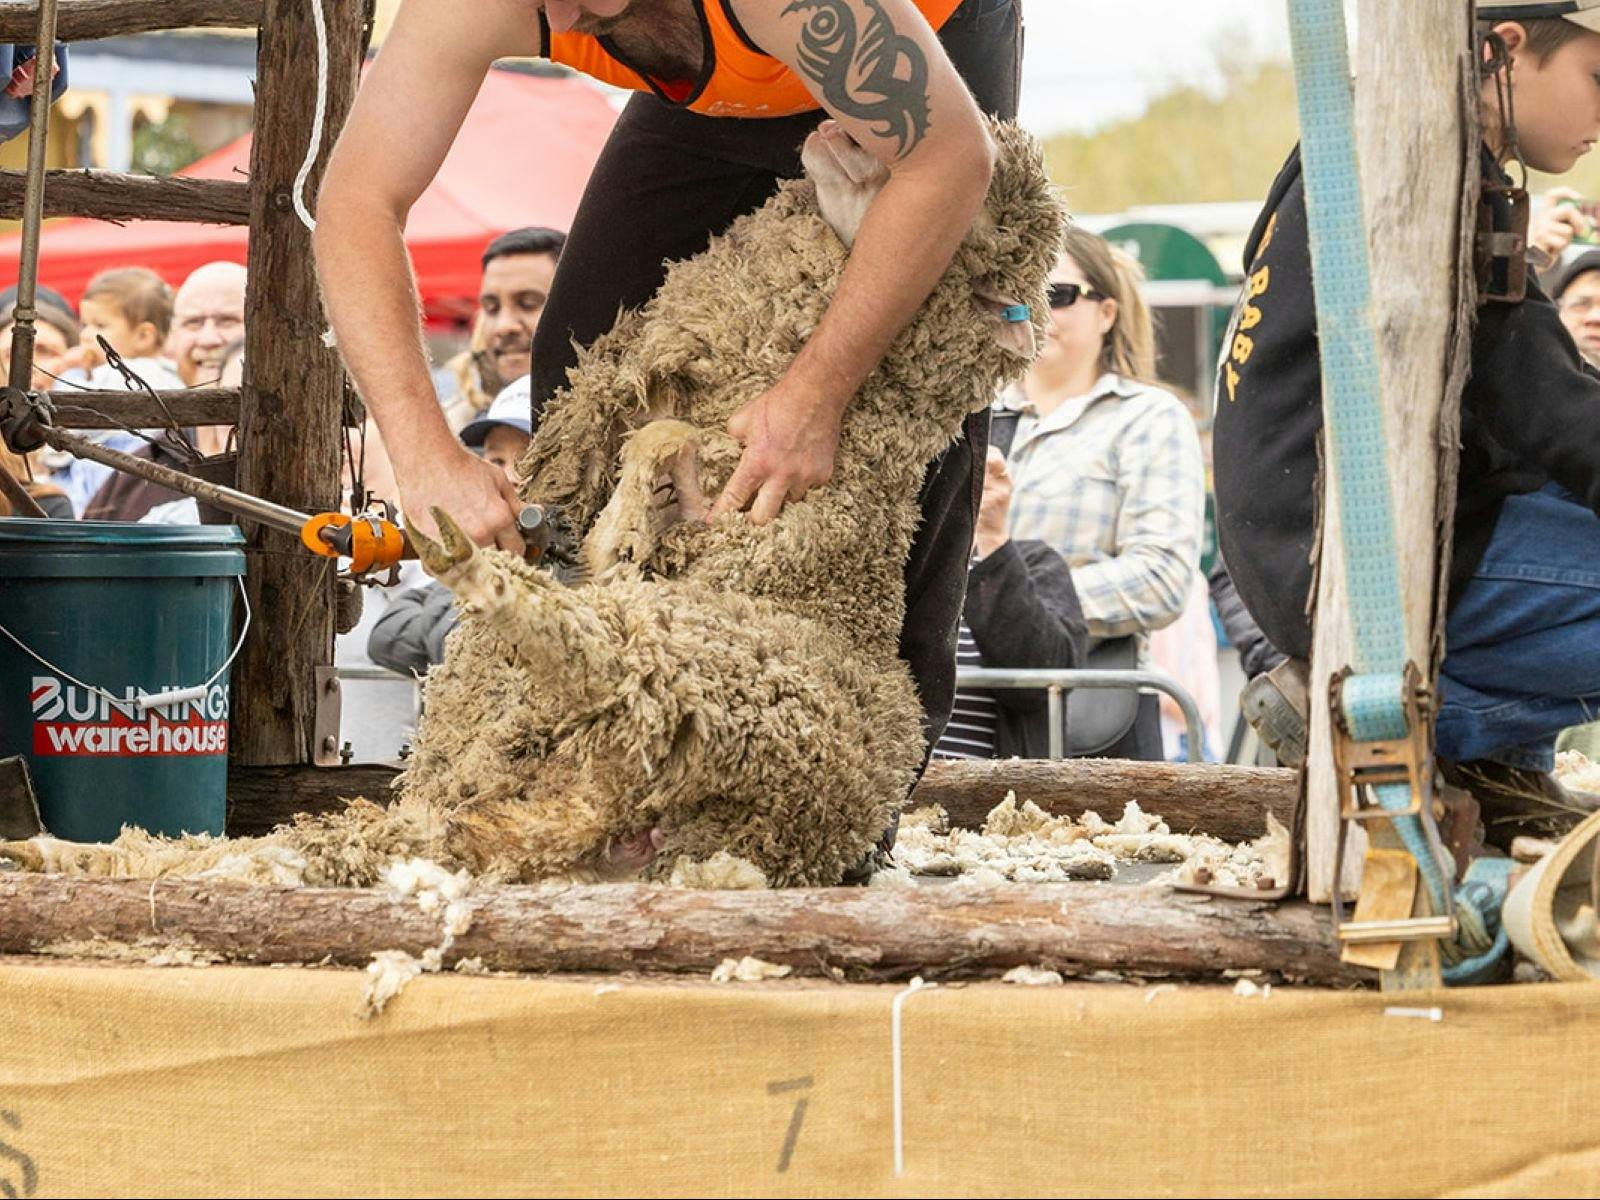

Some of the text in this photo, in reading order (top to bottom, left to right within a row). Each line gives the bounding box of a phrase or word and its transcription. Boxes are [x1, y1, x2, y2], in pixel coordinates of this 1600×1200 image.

[30, 676, 230, 721] BUNNINGS
[47, 713, 226, 753] warehouse
[767, 1075, 815, 1173] 7
